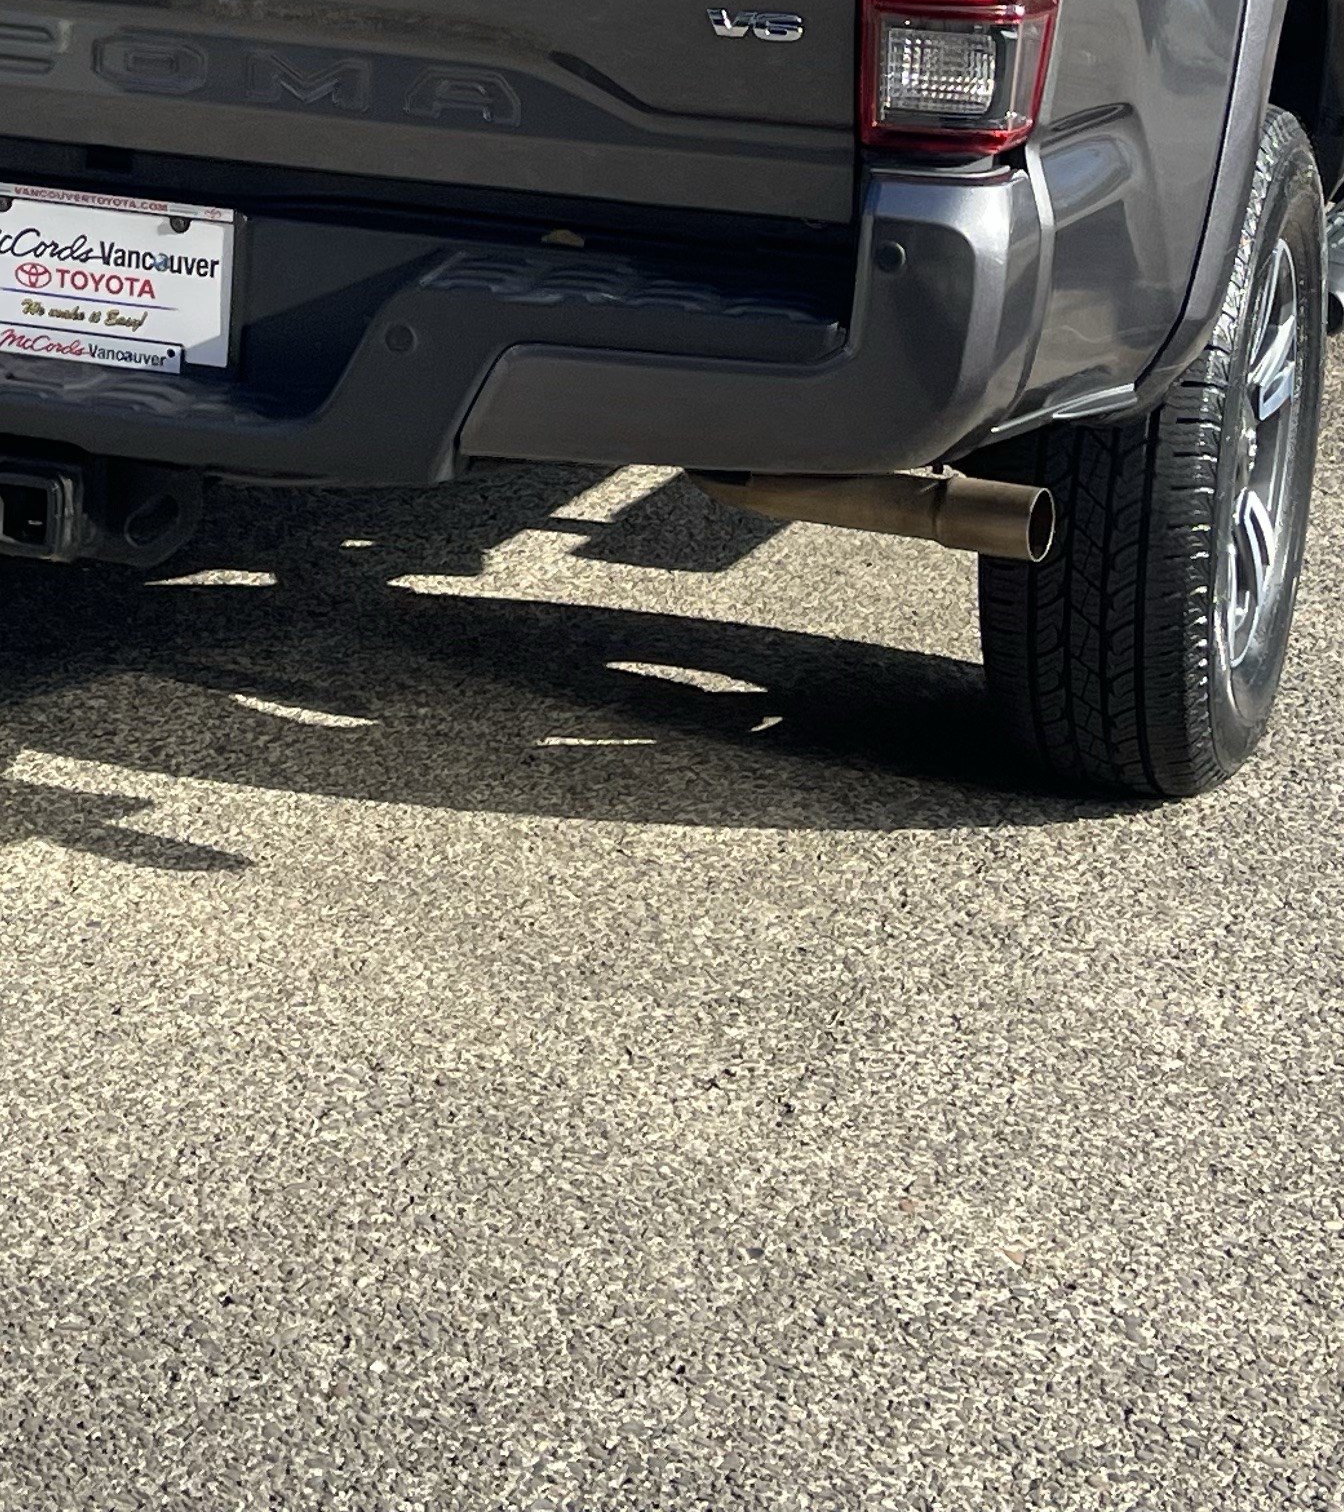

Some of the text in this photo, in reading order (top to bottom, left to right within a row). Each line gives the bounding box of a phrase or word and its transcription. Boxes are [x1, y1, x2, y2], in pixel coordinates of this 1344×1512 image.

[706, 7, 805, 42] V6
[13, 186, 169, 213] VANCOUVERTOYOTA.COM
[55, 268, 156, 300] TOYOTA
